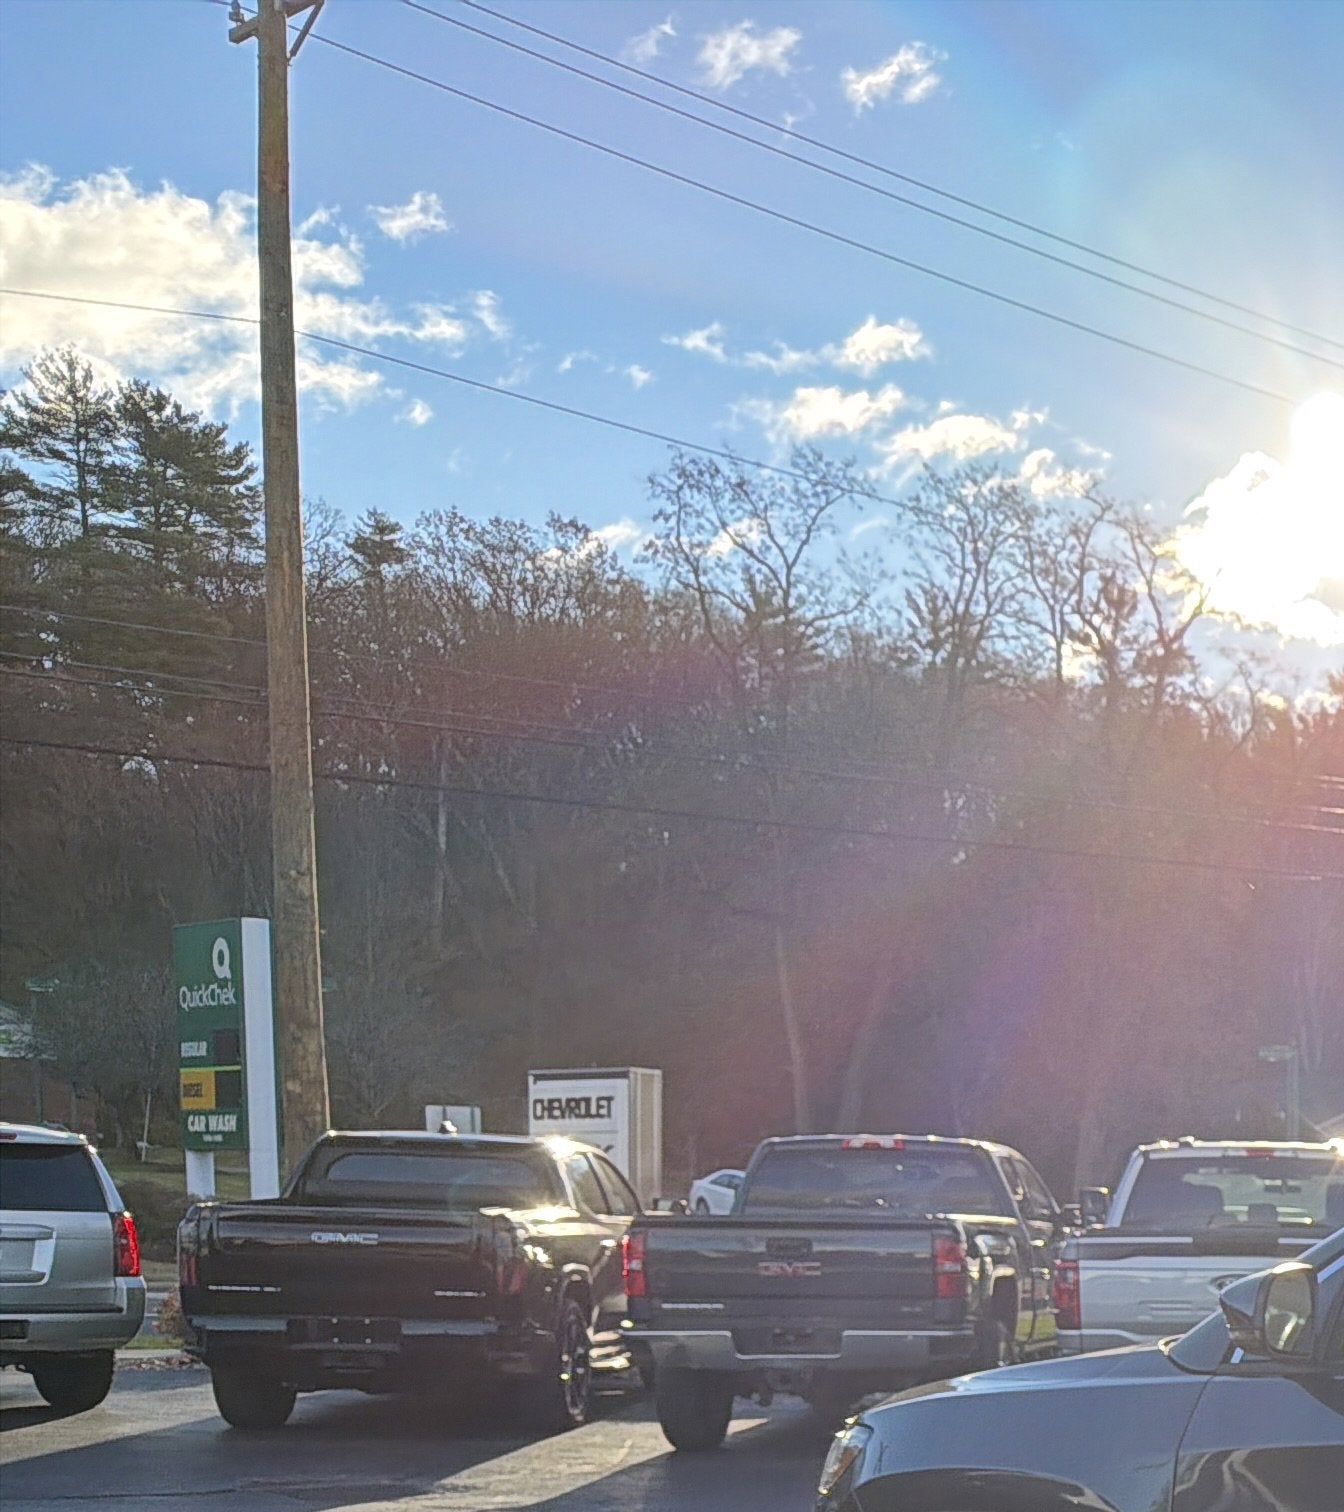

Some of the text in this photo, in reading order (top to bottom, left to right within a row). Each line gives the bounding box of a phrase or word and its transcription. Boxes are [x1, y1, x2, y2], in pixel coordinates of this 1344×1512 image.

[212, 936, 232, 980] Q
[180, 982, 237, 1012] QuickChek
[533, 1096, 614, 1120] CHEVROLET
[187, 1114, 237, 1133] CAR WASH
